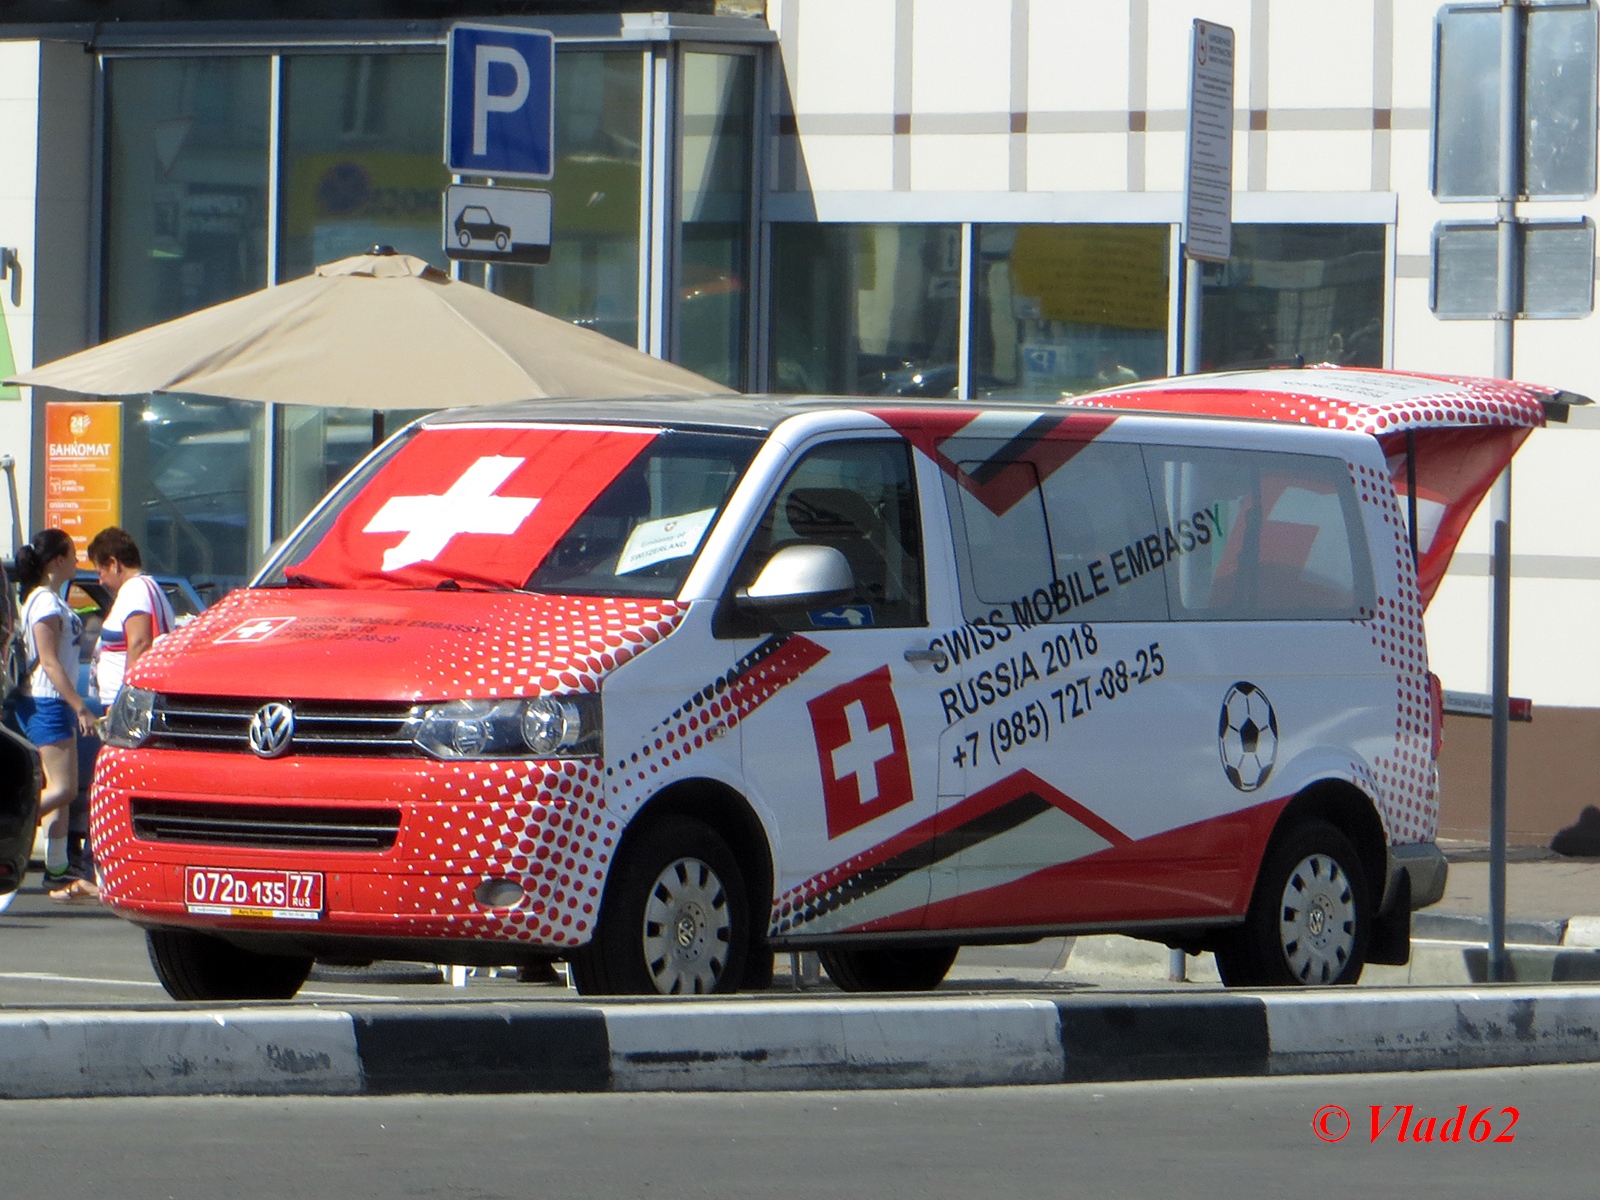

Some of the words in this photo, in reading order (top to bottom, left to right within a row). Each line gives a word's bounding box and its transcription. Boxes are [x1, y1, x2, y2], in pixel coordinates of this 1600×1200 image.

[473, 44, 531, 156] P
[49, 443, 111, 457] БАНКОМАТ
[929, 609, 1012, 674] SWISS
[1012, 560, 1110, 632] MOBILE
[1110, 503, 1223, 585] EMBASSY
[940, 652, 1040, 725] RUSSIA
[1042, 624, 1098, 676] 2018
[953, 731, 980, 768] +7
[989, 700, 1049, 765] (985)
[1051, 643, 1166, 724] 727-08-25
[290, 875, 313, 898] 77
[292, 897, 311, 907] RUS
